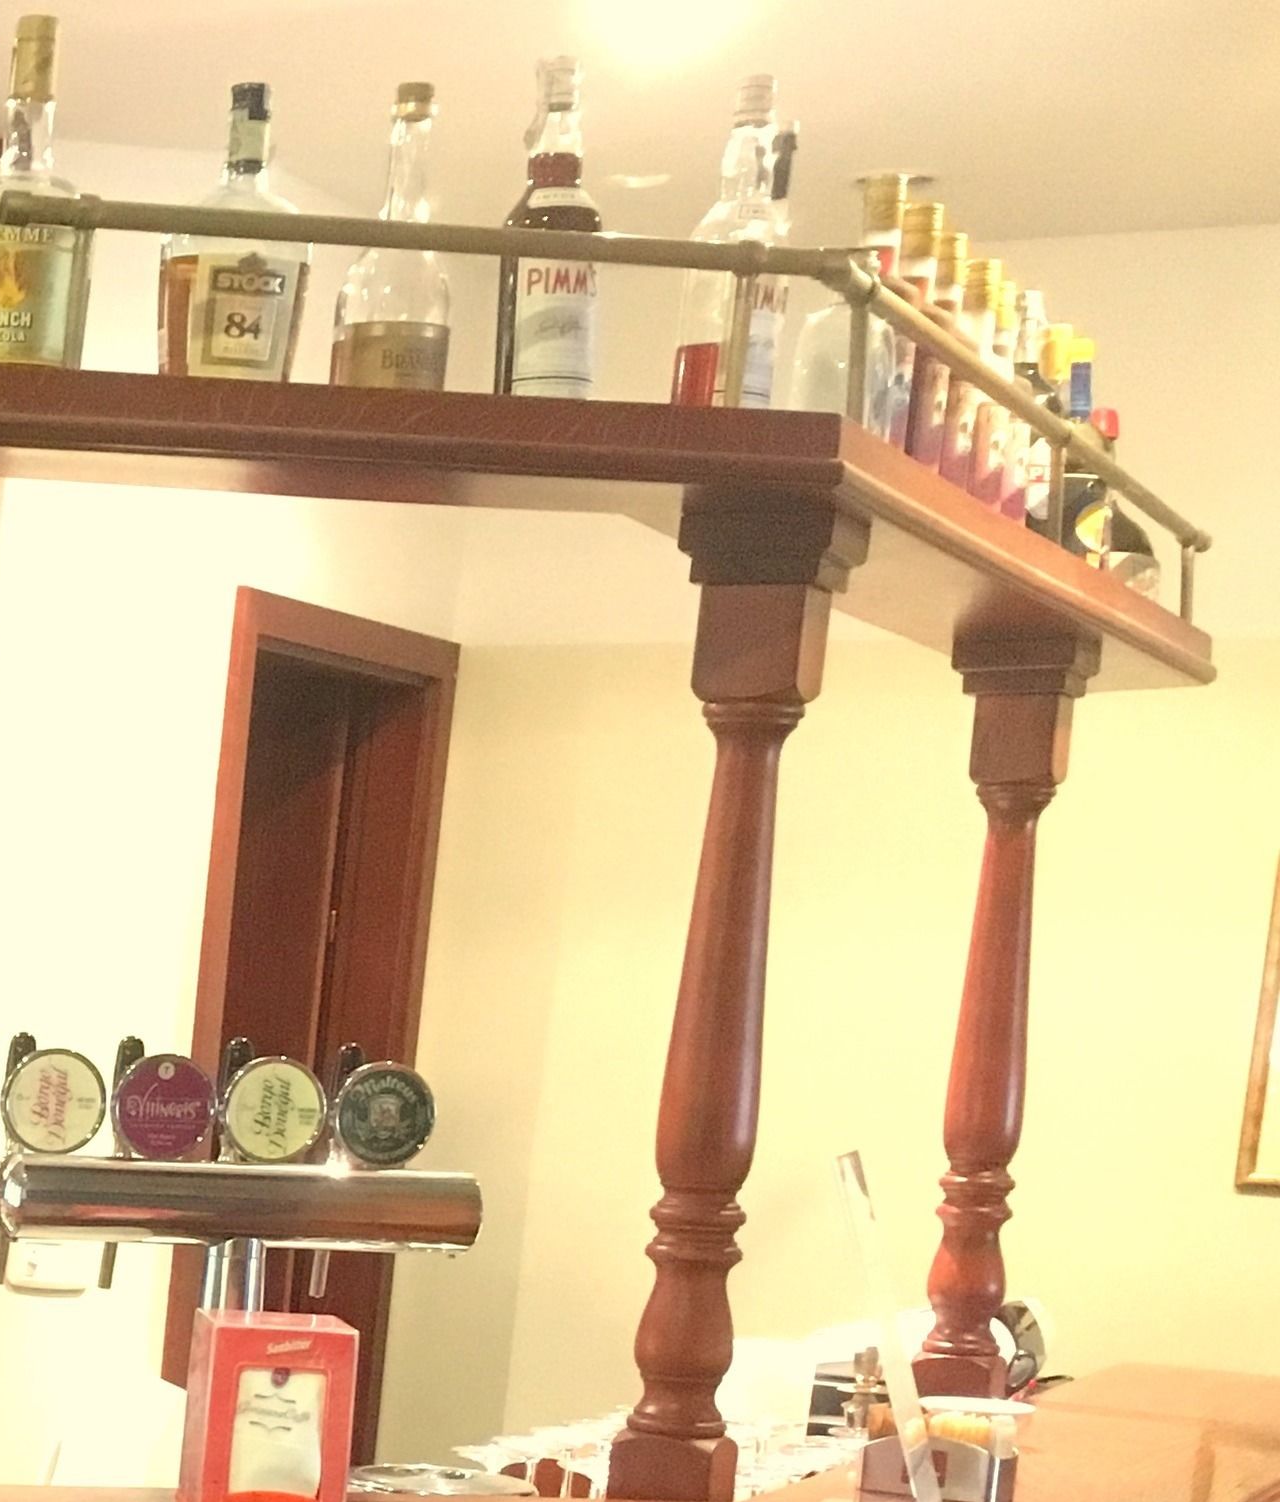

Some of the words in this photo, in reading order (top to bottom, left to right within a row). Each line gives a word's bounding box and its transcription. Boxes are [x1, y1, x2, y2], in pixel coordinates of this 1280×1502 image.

[215, 272, 283, 293] STOCK
[224, 312, 262, 340] 84
[252, 1079, 276, 1136] Borgo
